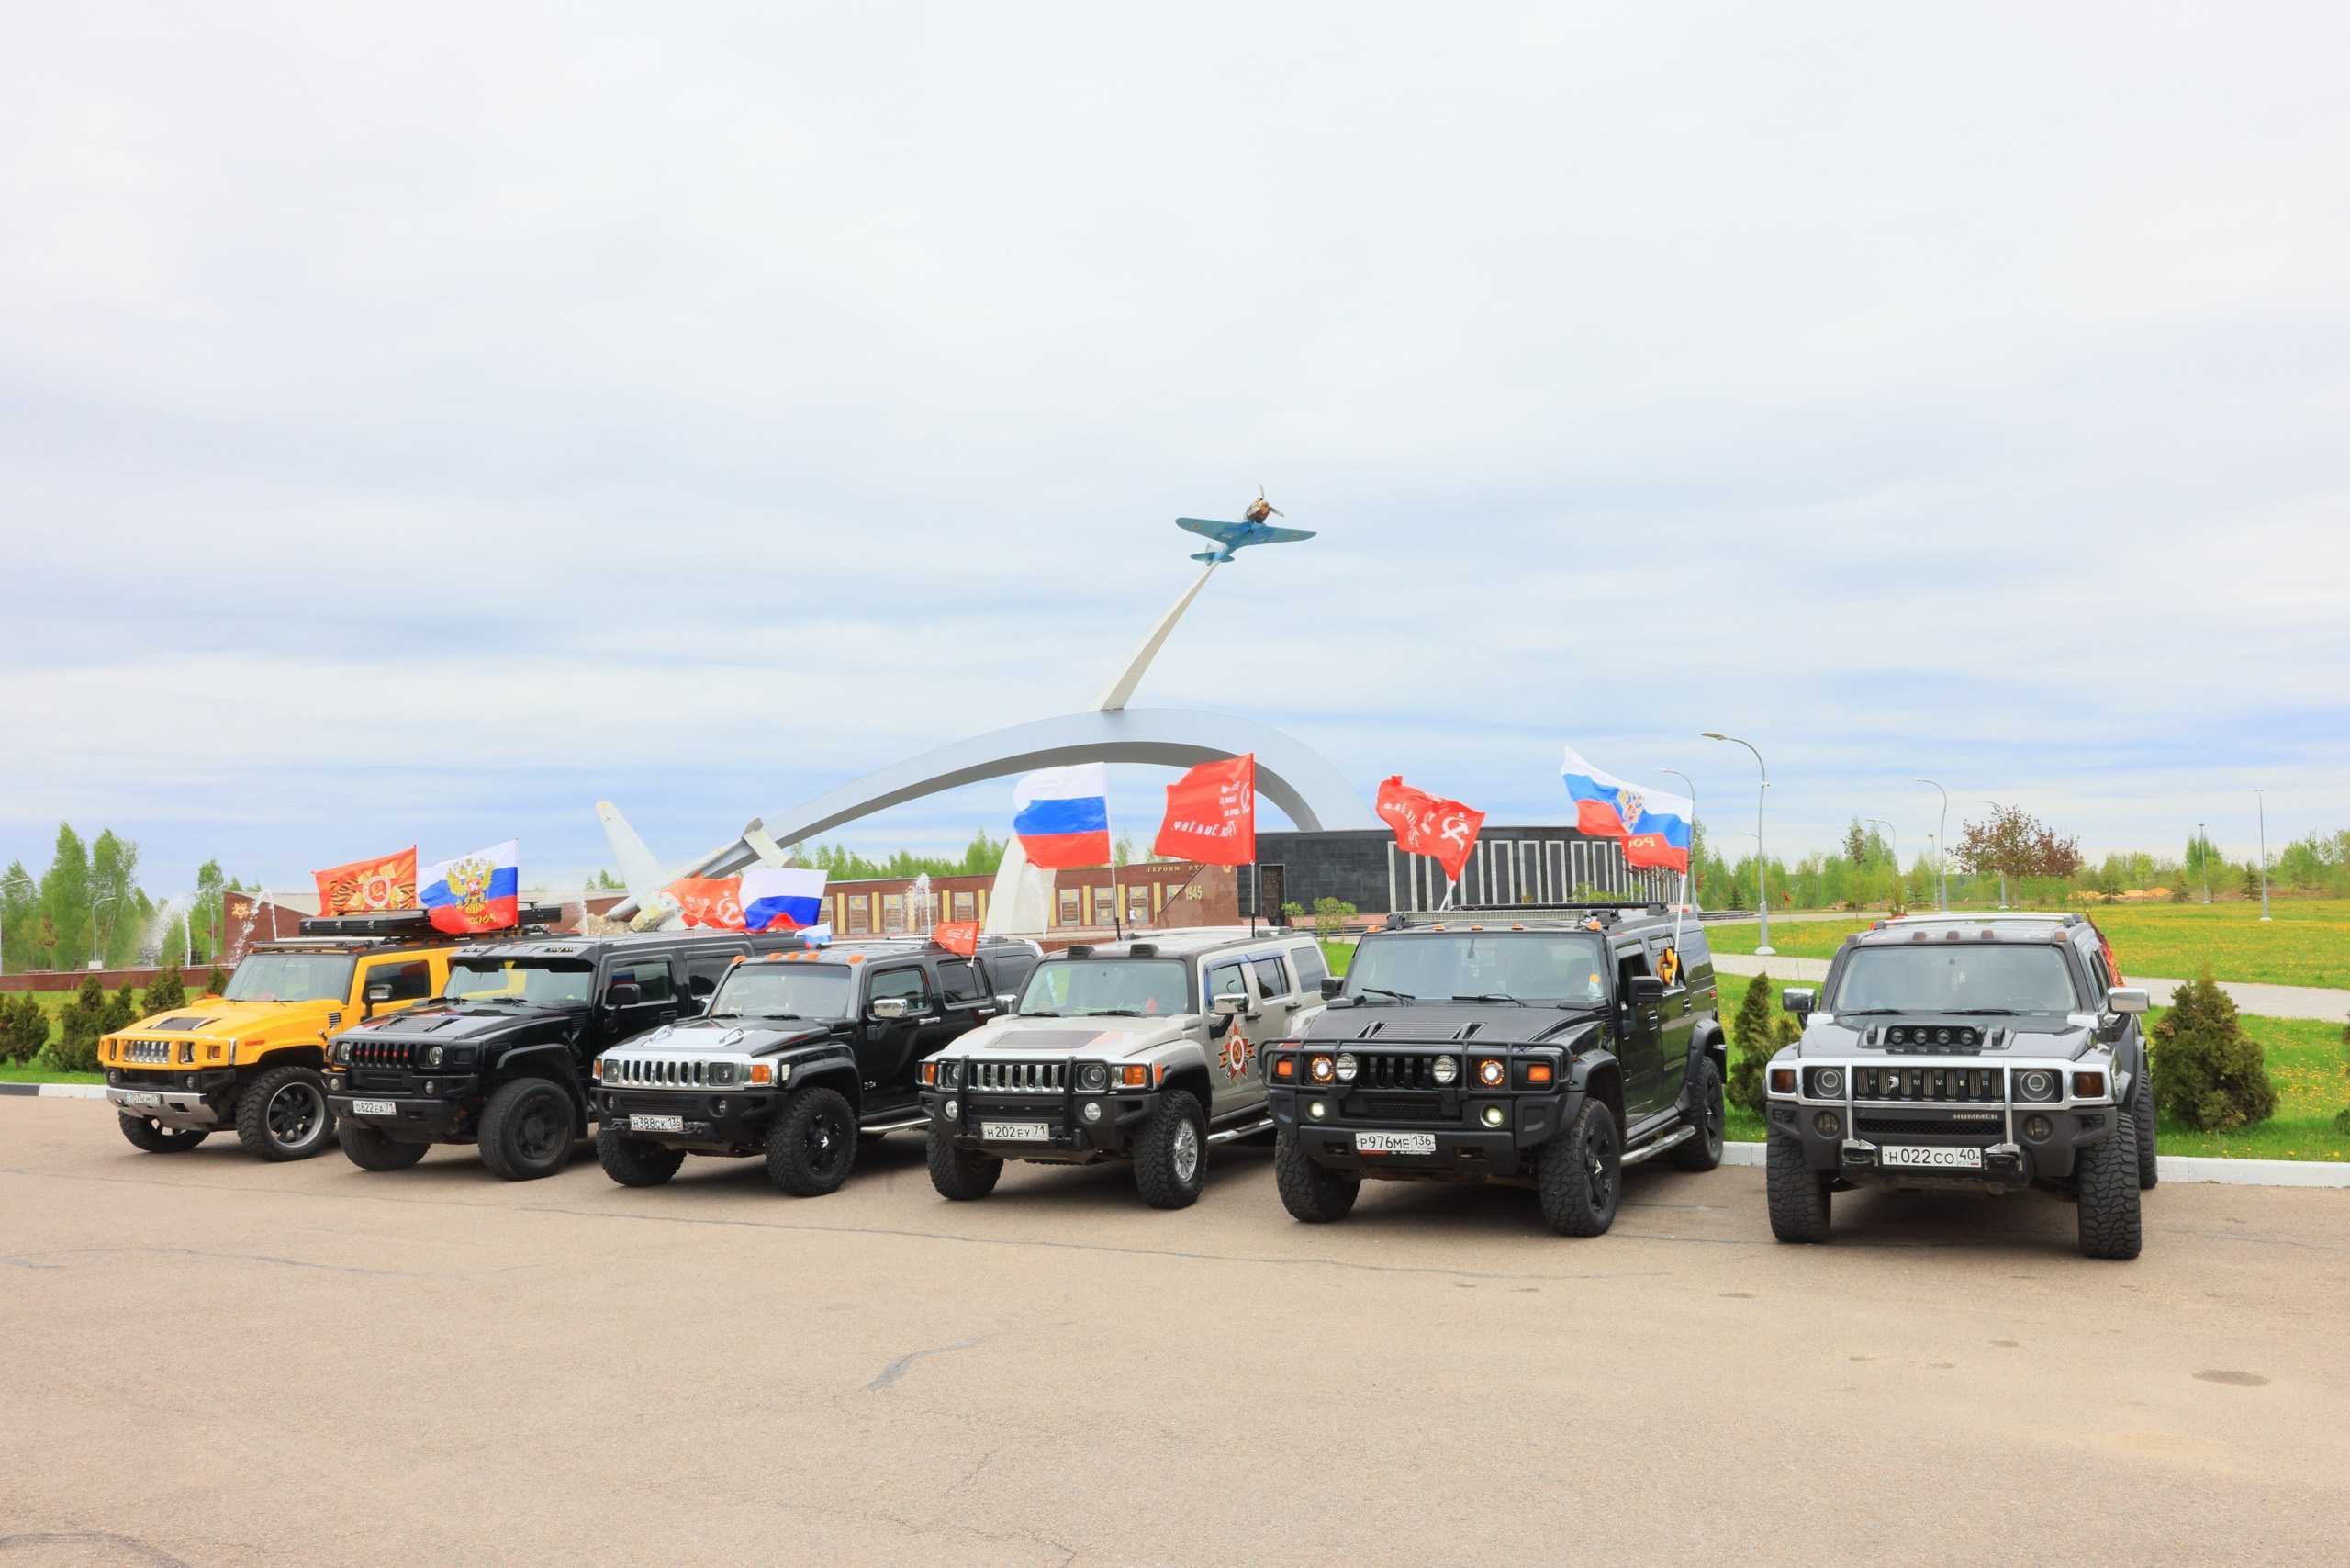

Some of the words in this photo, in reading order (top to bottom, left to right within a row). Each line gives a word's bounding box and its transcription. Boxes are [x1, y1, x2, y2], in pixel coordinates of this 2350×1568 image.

[1185, 885, 1203, 901] 1945
[1033, 1125, 1045, 1135] 71
[1412, 1135, 1431, 1146] 136
[1959, 1148, 1975, 1160] 40
